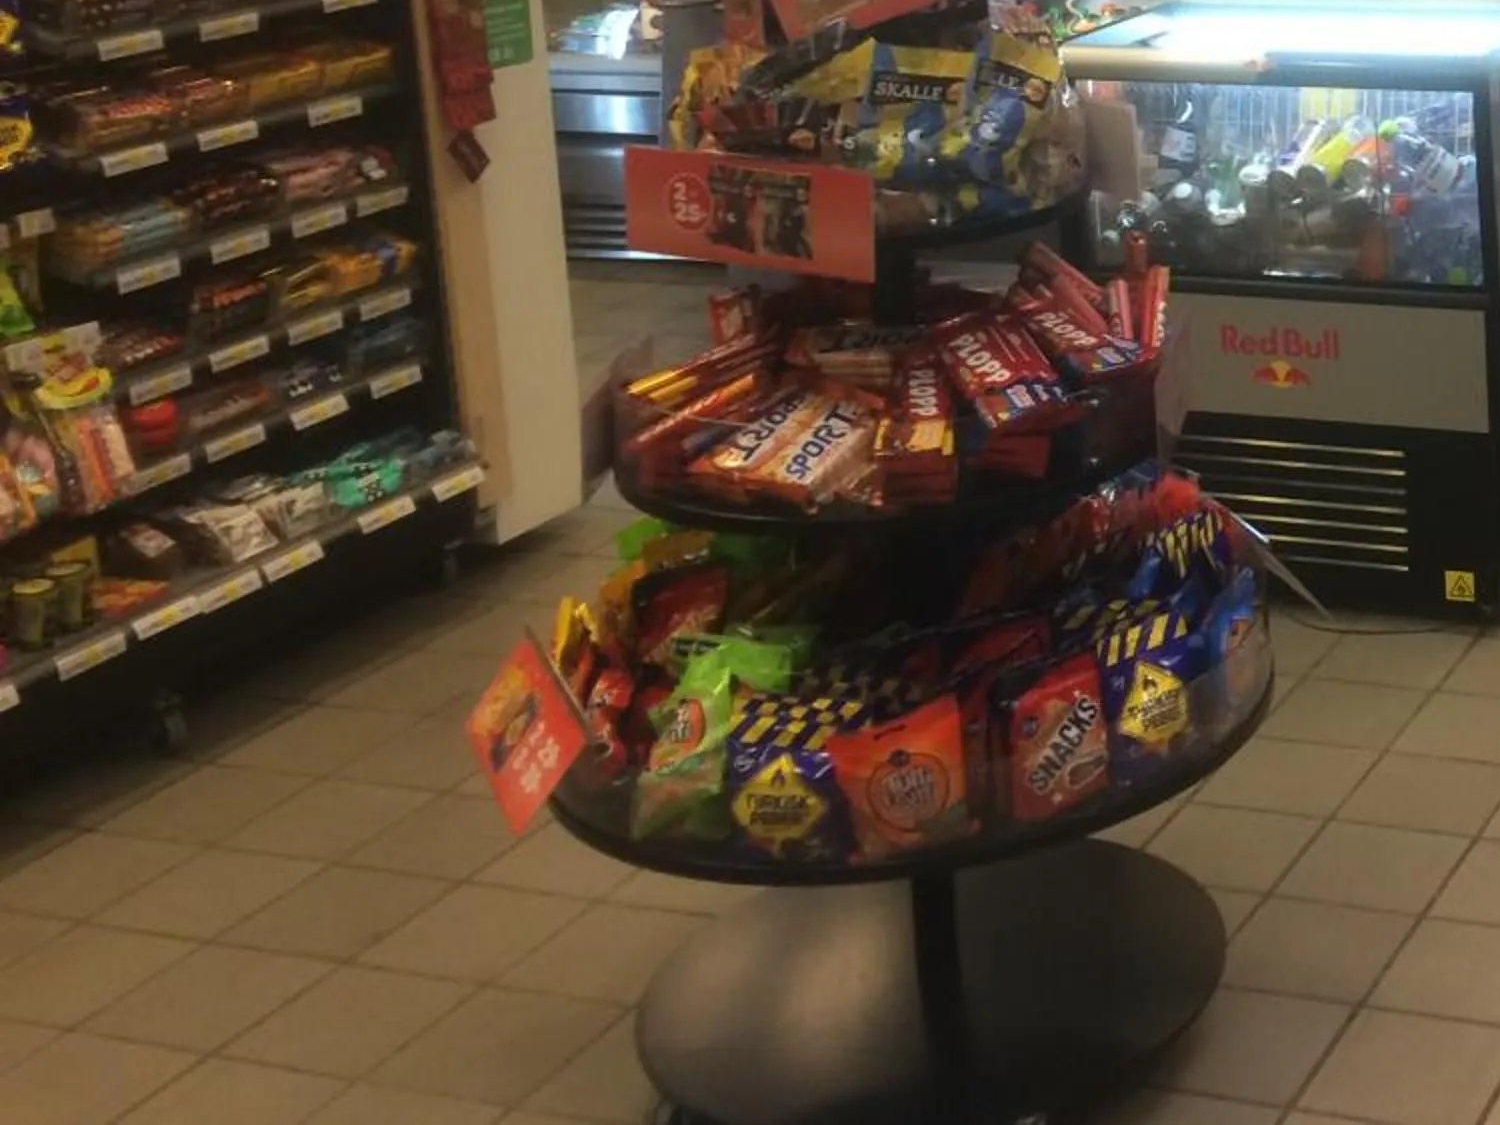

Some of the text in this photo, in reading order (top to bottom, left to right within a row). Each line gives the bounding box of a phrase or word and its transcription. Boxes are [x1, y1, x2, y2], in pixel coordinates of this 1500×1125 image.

[874, 81, 943, 102] SKALLE
[1033, 311, 1098, 348] PLOPP
[1220, 324, 1339, 361] Red Bull
[950, 331, 1011, 383] PLOPP
[908, 369, 942, 417] PLOPP
[784, 403, 857, 480] SPORT
[1029, 696, 1098, 792] SNACKS
